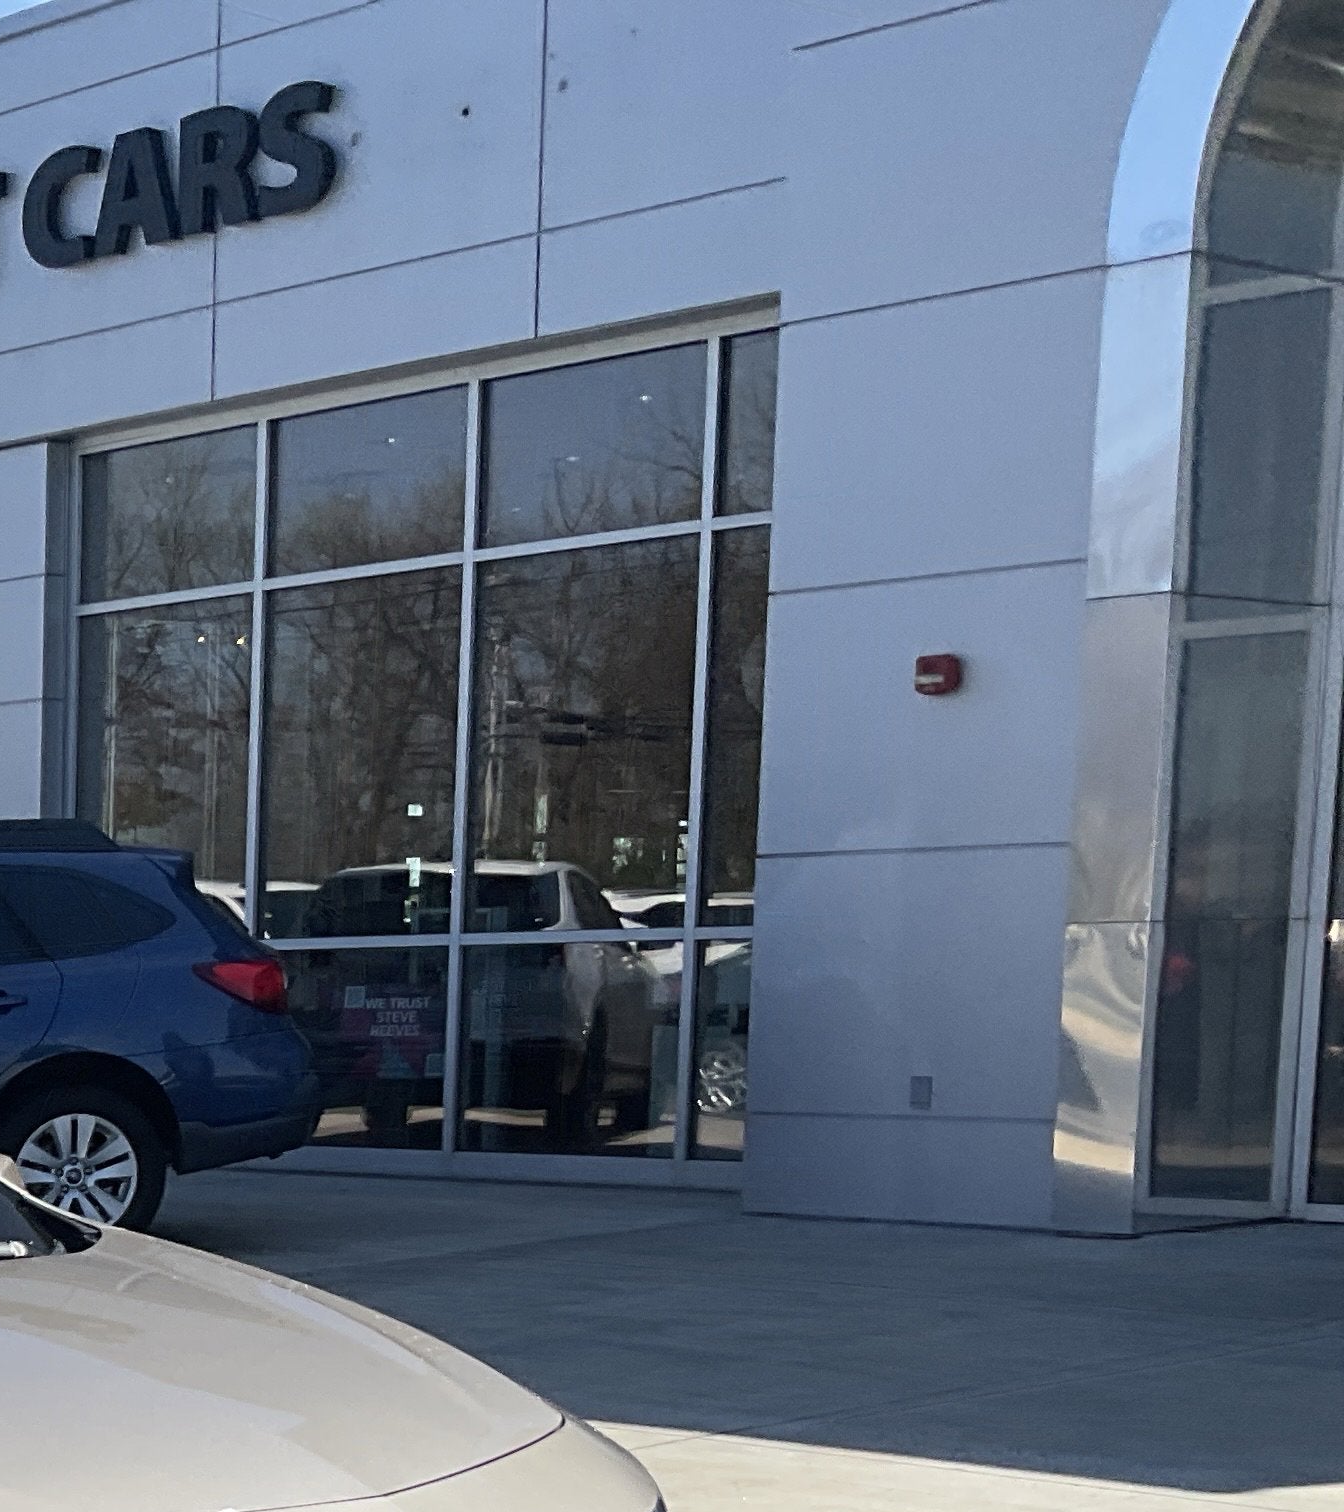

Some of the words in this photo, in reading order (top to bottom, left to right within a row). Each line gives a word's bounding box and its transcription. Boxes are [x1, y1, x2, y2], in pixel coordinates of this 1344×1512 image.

[22, 79, 341, 269] CARS
[366, 998, 386, 1008] WE
[391, 997, 431, 1008] TRUST
[376, 1011, 417, 1023] STEVE
